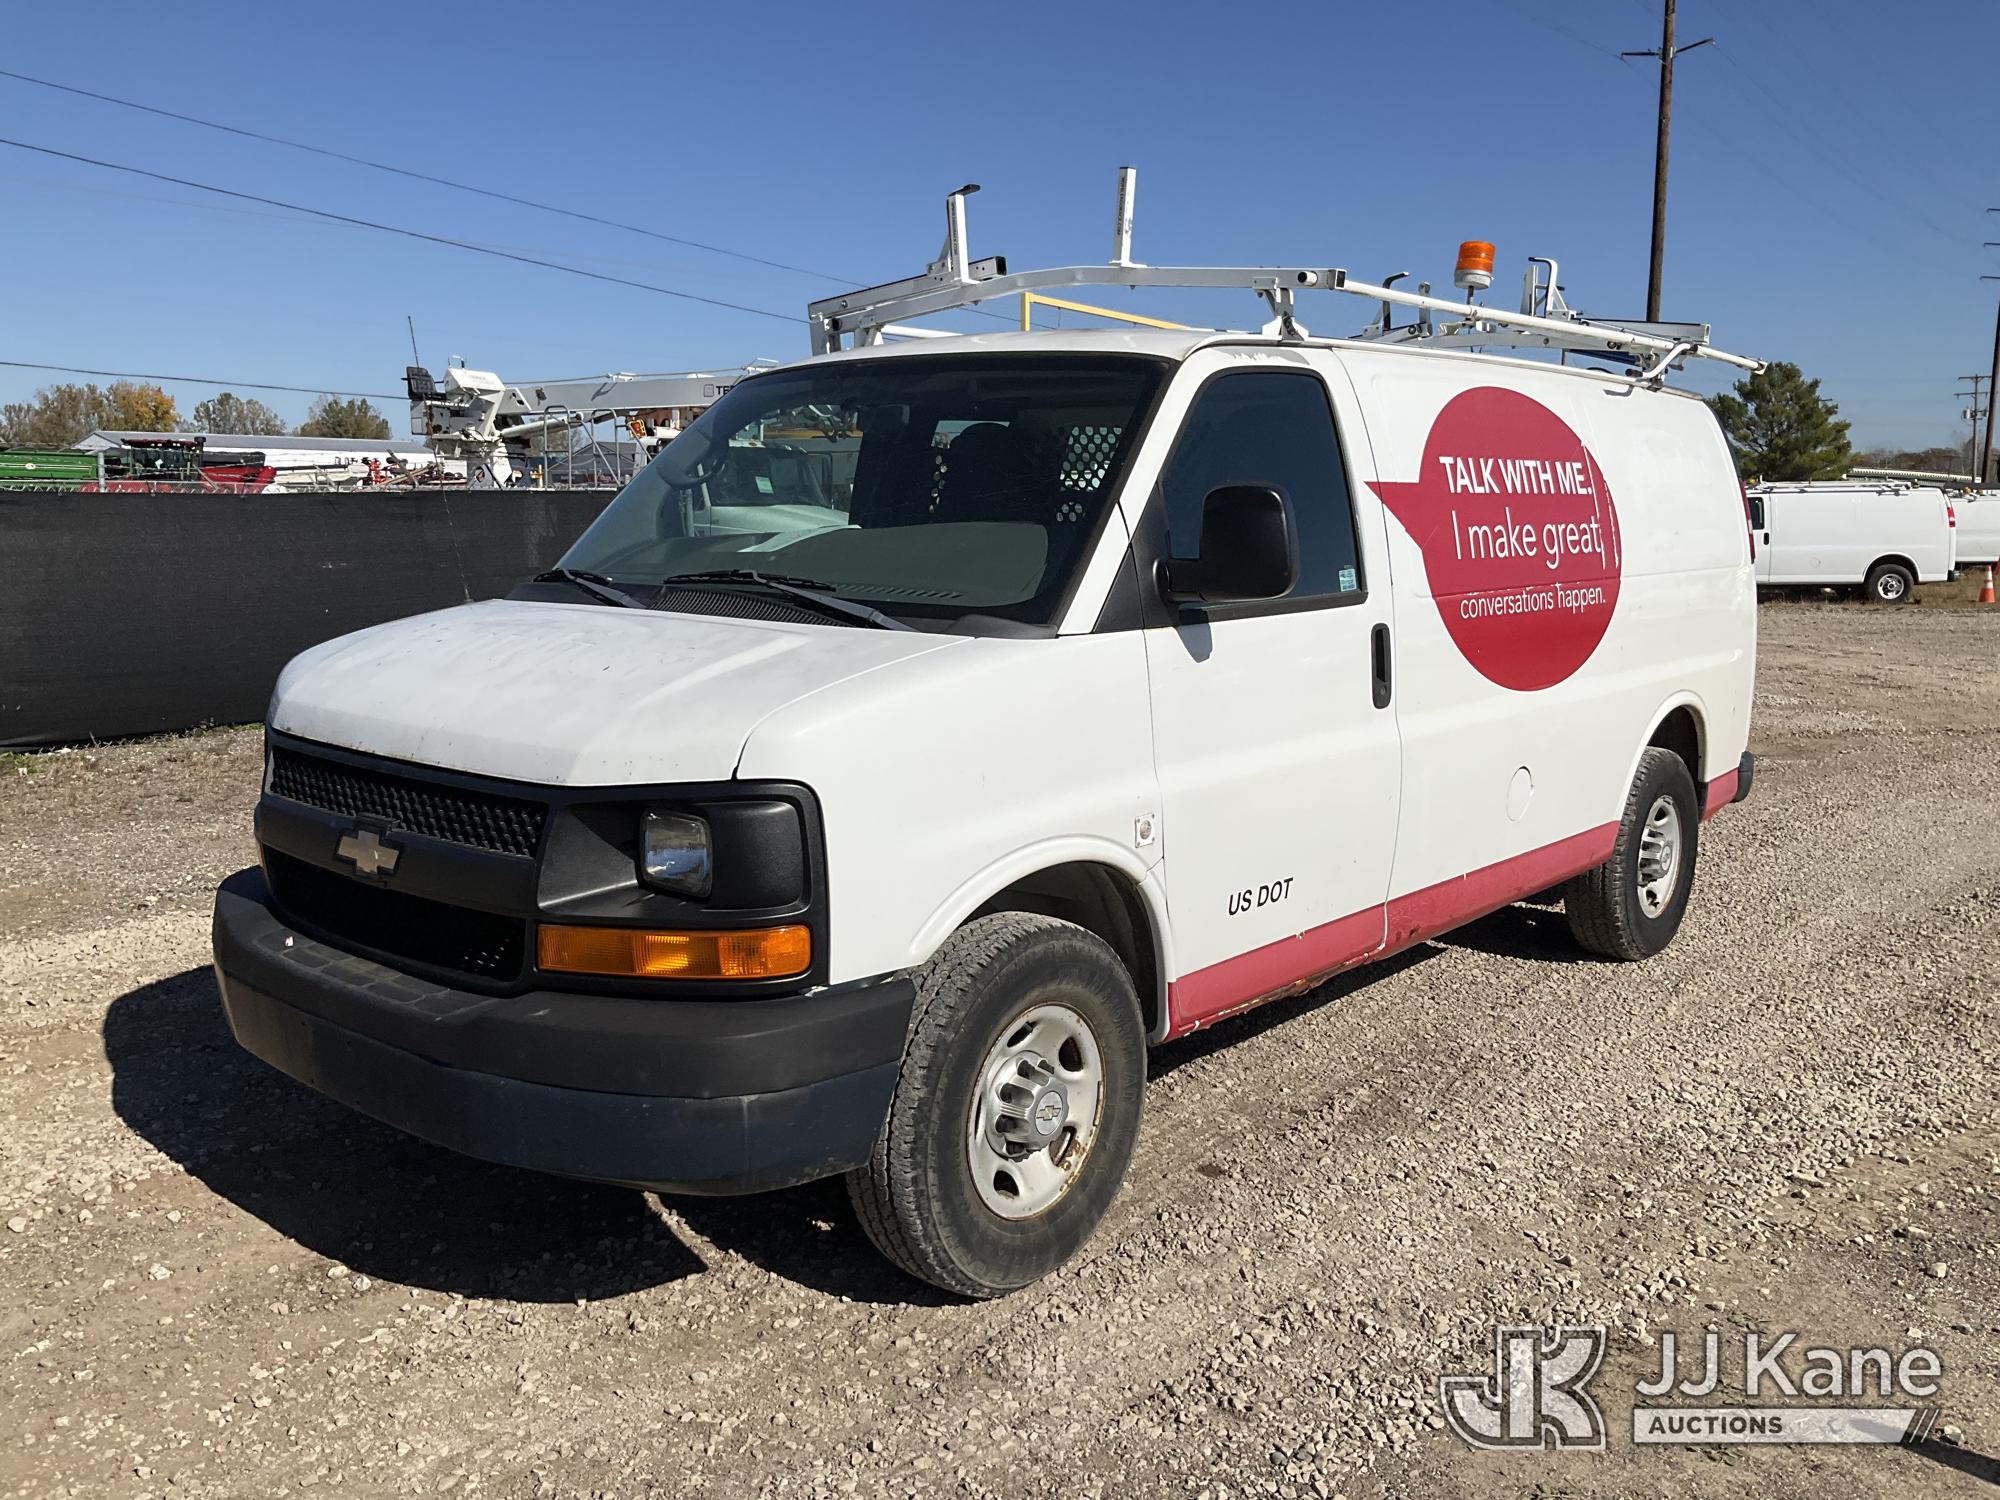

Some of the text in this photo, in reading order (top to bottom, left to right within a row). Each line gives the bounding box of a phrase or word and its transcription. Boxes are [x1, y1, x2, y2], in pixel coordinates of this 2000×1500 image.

[1439, 456, 1592, 495] TALK WITH ME.
[1452, 509, 1462, 560] I
[1468, 506, 1537, 559] make
[1460, 583, 1606, 619] conversations happen.
[1228, 877, 1293, 915] US DOT
